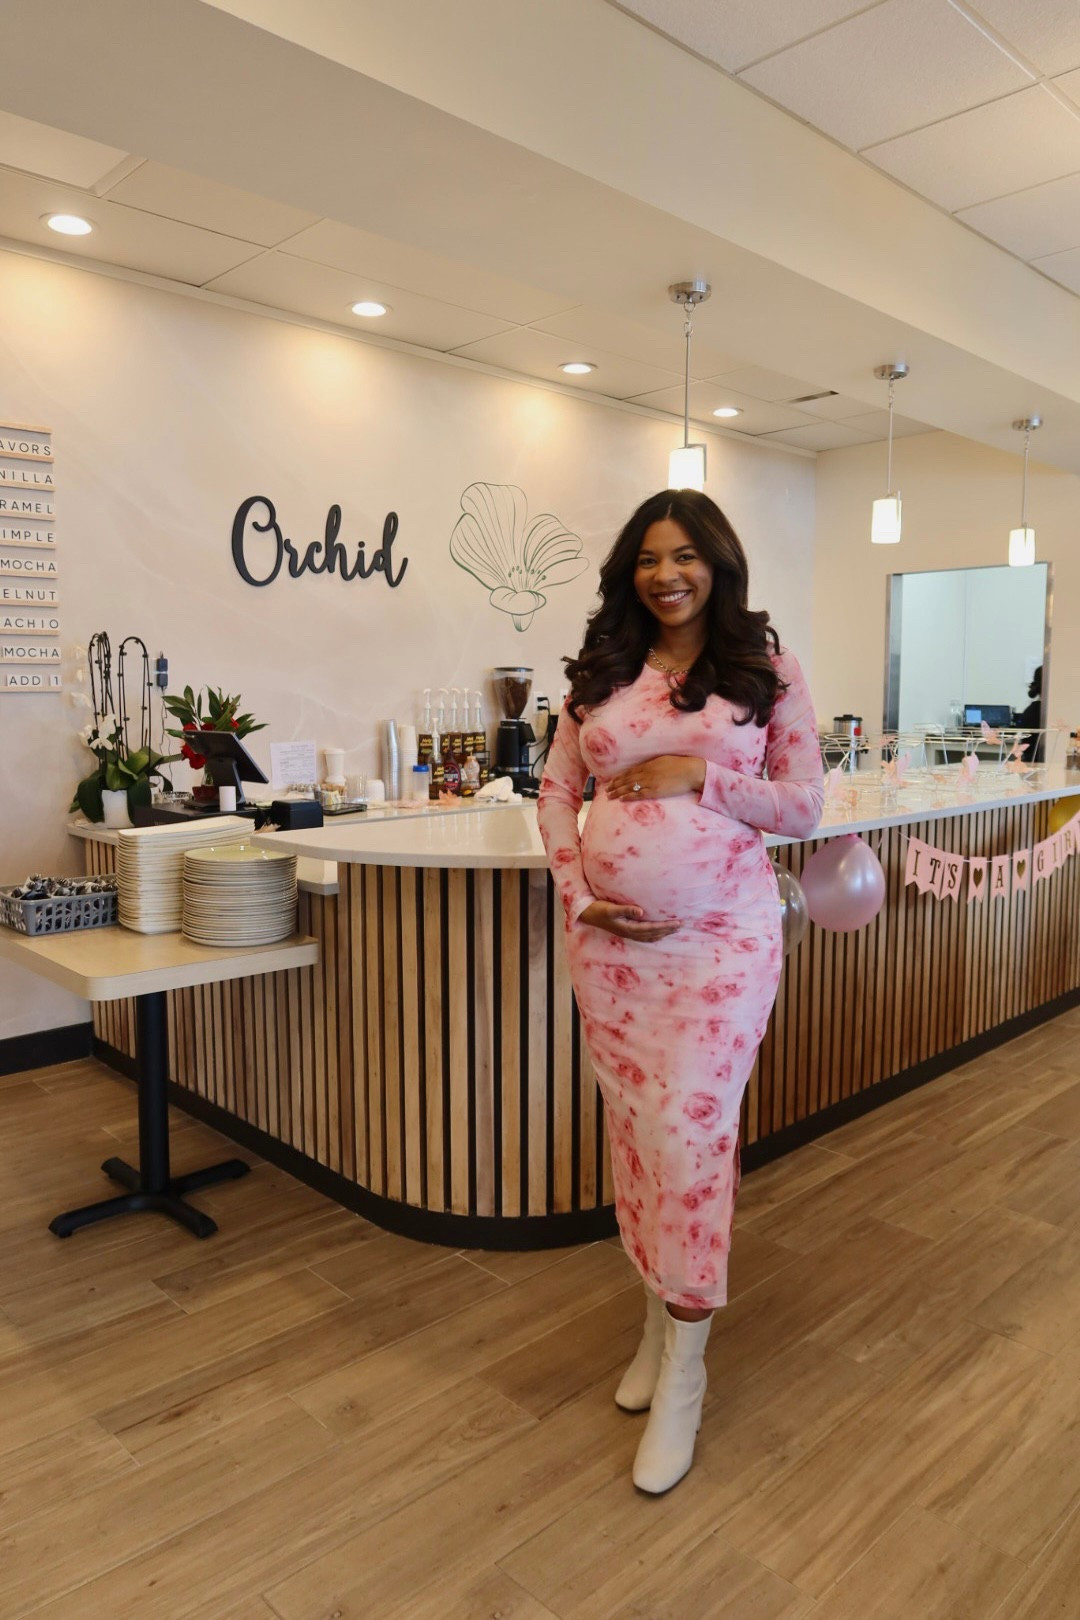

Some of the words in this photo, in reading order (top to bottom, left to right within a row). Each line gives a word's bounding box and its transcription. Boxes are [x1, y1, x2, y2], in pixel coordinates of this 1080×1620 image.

[0, 499, 53, 514] RAMEL
[231, 495, 409, 588] Orchid
[0, 559, 56, 571] MOCHA
[3, 588, 56, 600] ELNUT
[4, 617, 59, 629] ACHIO
[4, 647, 59, 658] MOCHA
[9, 675, 41, 686] ADD
[54, 676, 58, 686] 1
[912, 849, 958, 889] IT'S
[995, 865, 1004, 888] A
